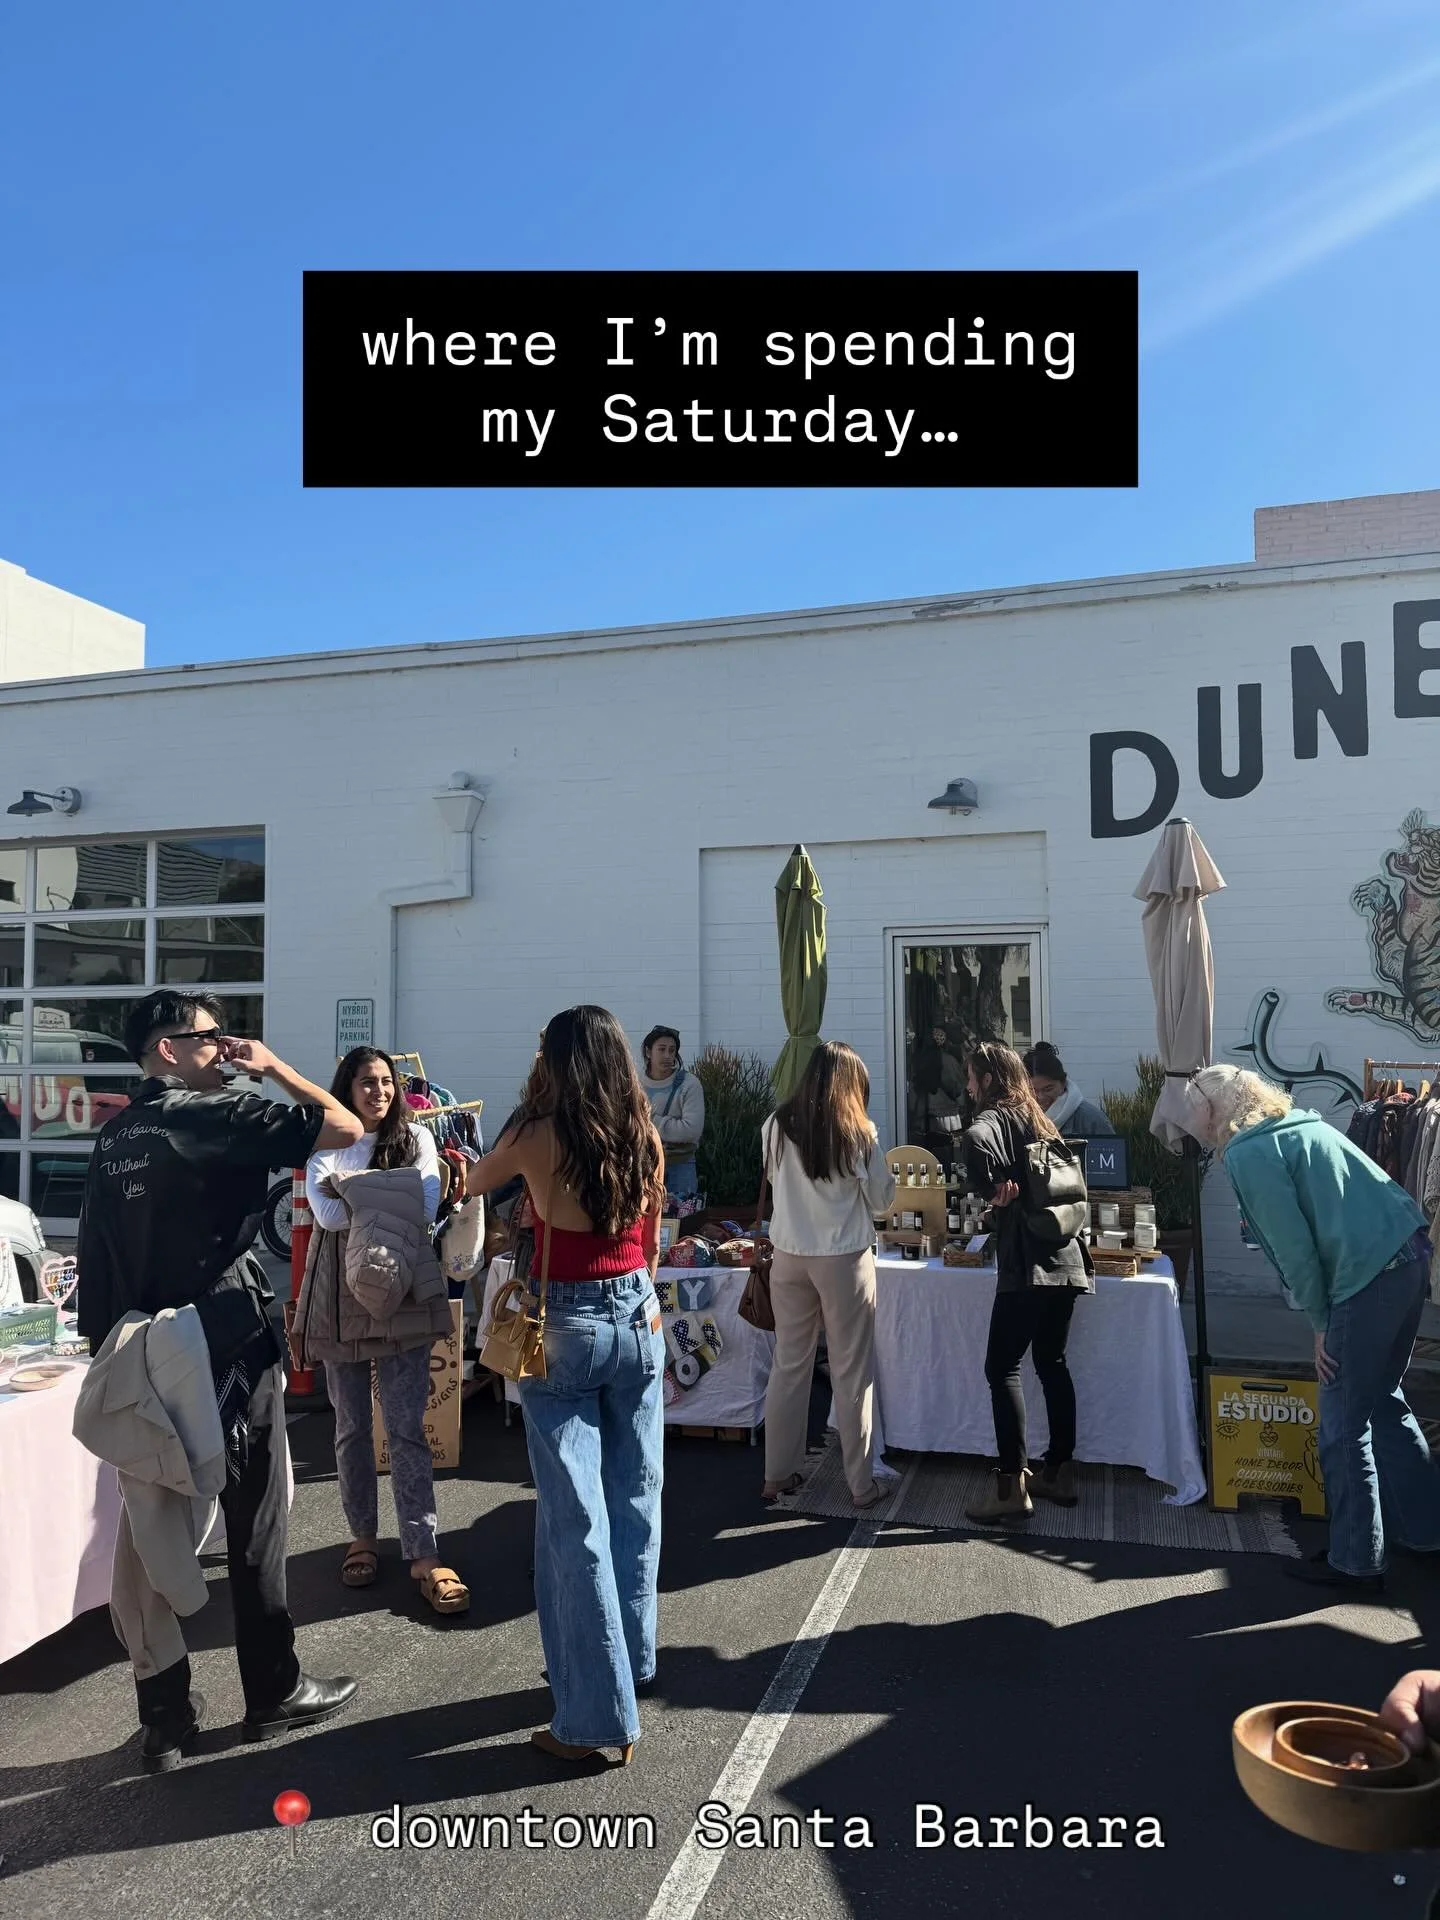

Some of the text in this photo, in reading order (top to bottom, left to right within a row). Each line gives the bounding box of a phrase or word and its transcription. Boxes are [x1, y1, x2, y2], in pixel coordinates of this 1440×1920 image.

[1090, 599, 1440, 839] DUNE
[343, 1005, 368, 1015] HYBRID
[341, 1018, 369, 1028] VEHICLE
[340, 1031, 370, 1041] PARKING
[100, 1153, 150, 1175] Without
[123, 1180, 146, 1200] You
[1223, 1391, 1306, 1406] LA SEGUNDA
[1217, 1401, 1315, 1424] ESTUDIO
[1235, 1457, 1304, 1471] HOME DECOR
[1237, 1468, 1293, 1481] CLOTHING
[1226, 1478, 1304, 1494] ACCESSORIES
